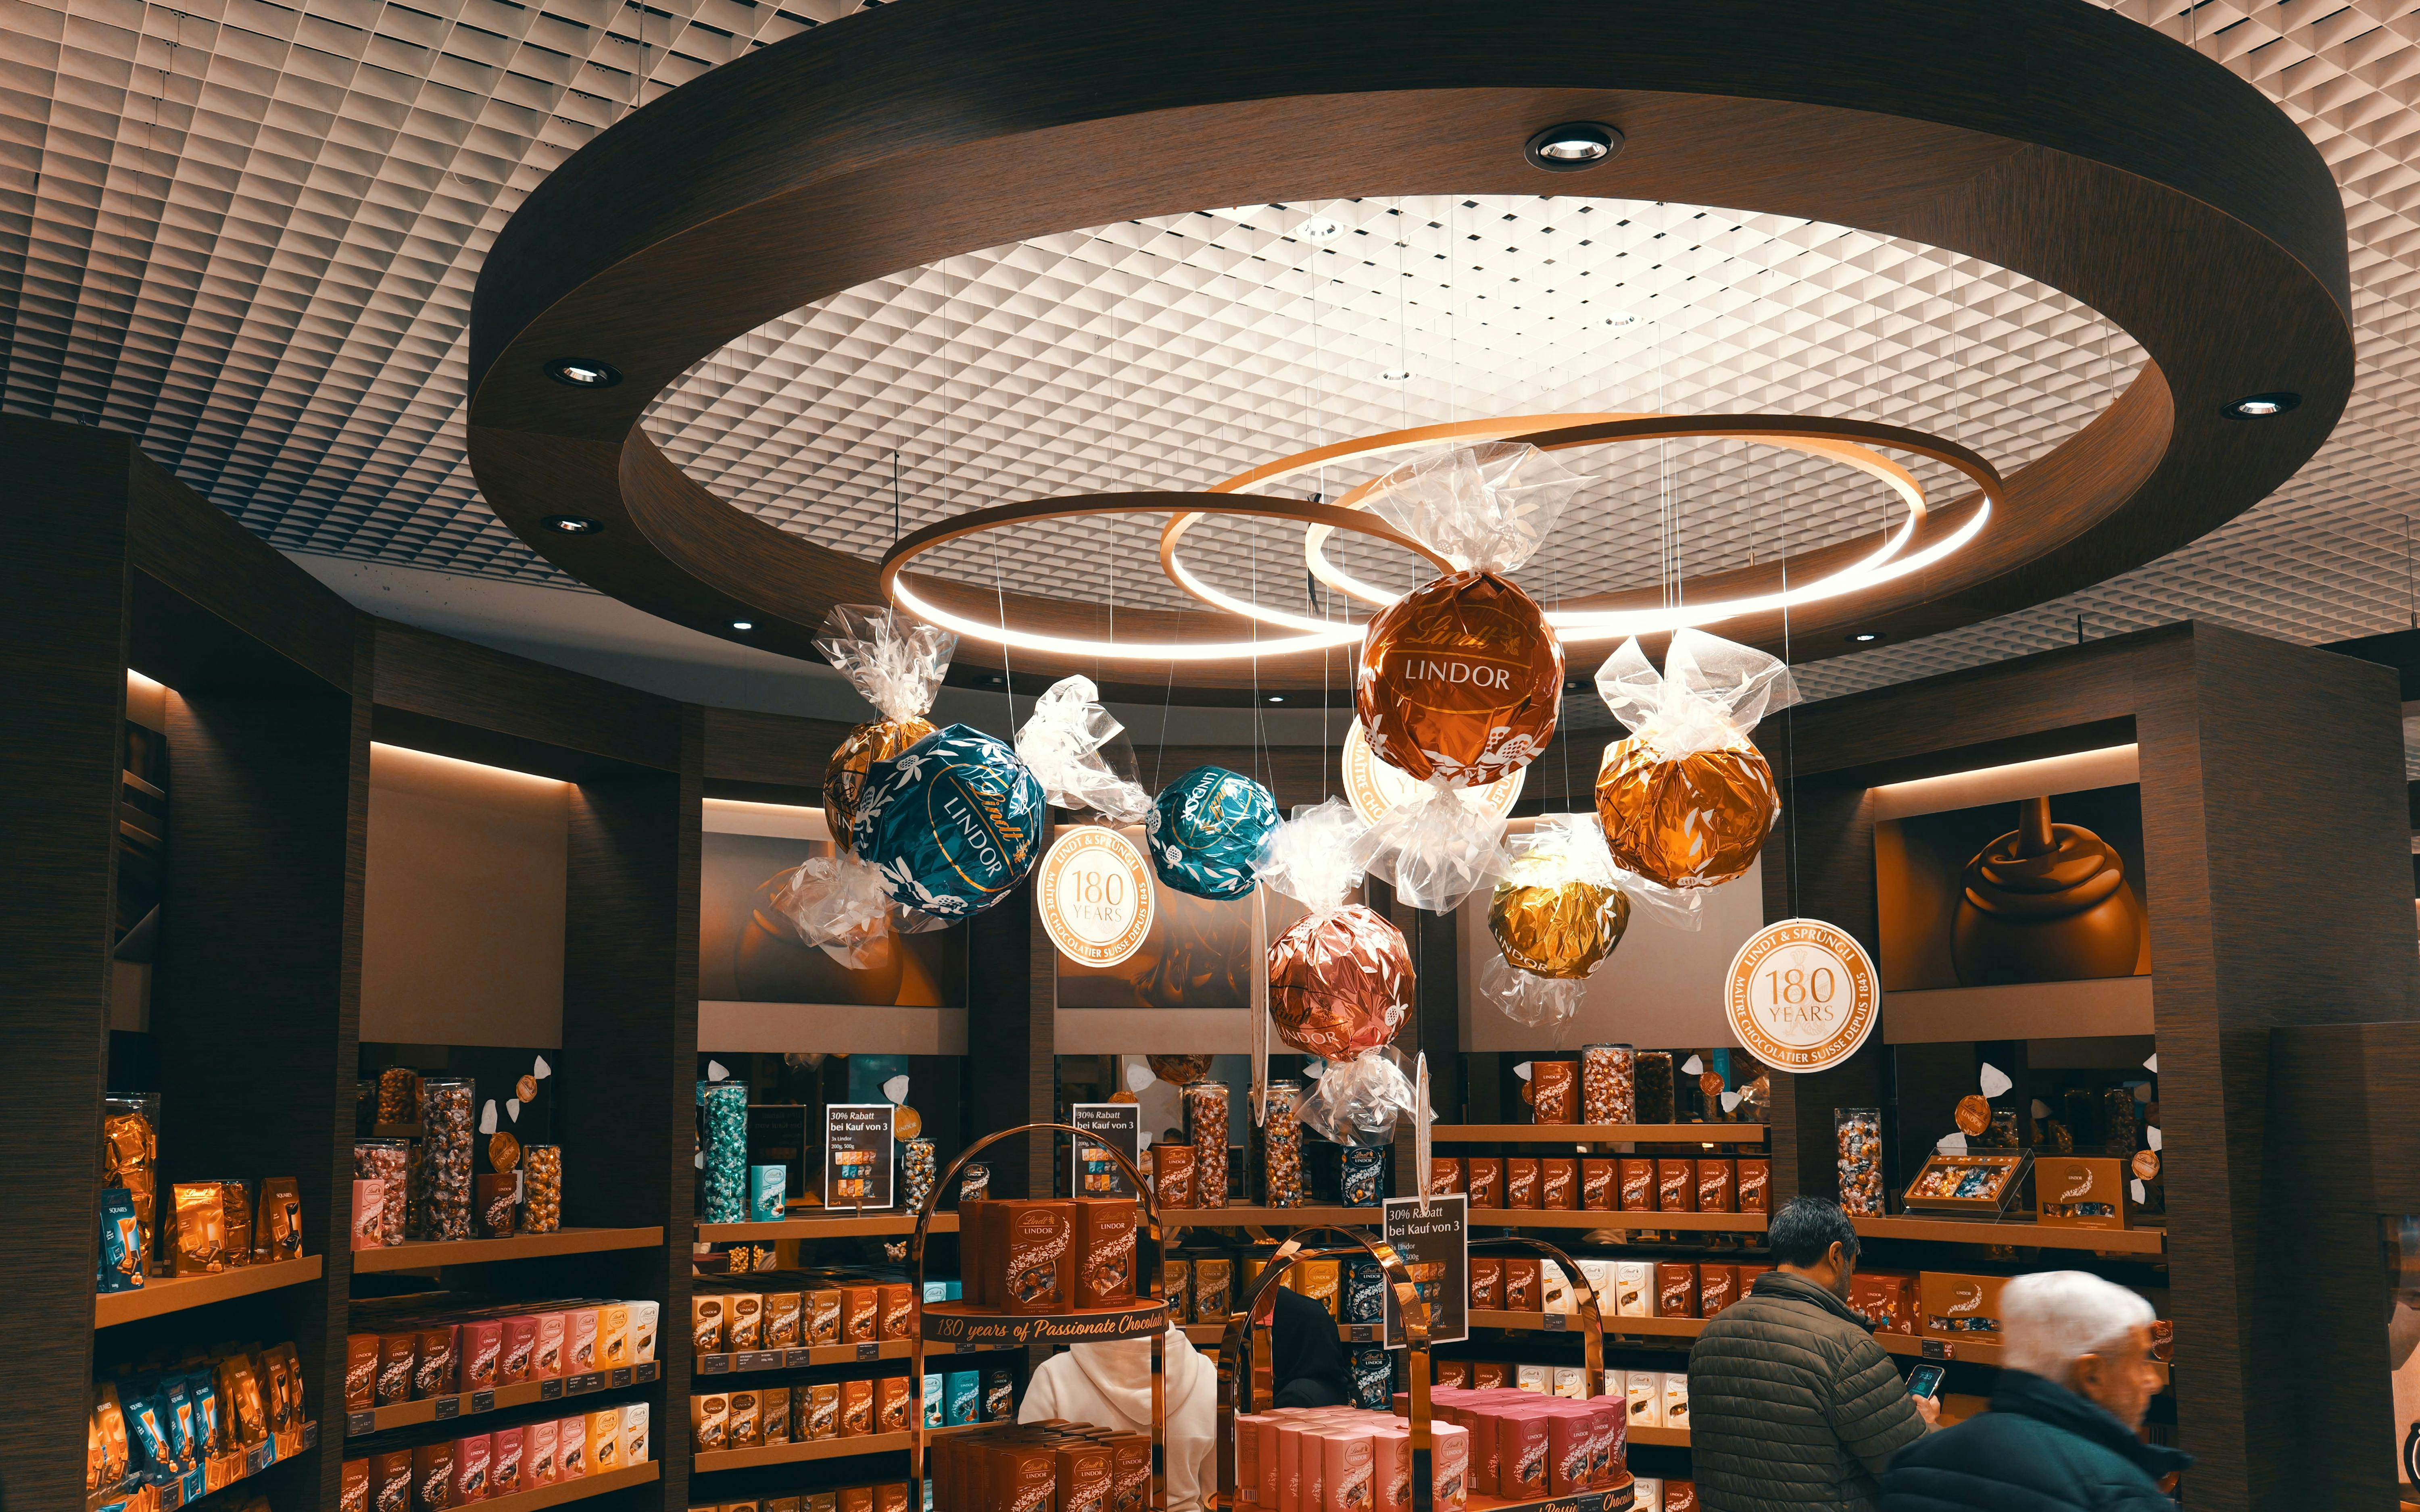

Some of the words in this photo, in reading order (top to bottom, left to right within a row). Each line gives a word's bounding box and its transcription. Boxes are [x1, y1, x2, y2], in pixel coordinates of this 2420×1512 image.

[1405, 616, 1499, 649] Lindt
[1405, 660, 1510, 690] LINDOR
[943, 796, 1002, 878] LINDOR
[1055, 835, 1082, 864] LINDT
[1085, 835, 1093, 845] &
[1094, 835, 1139, 871] SPRÜNGLI
[1046, 871, 1056, 910] MAÎTRE
[1072, 870, 1124, 905] 180
[1139, 882, 1148, 905] 1845
[1073, 904, 1121, 922] YEARS
[1050, 912, 1101, 958] CHOCOLATIER
[1128, 908, 1147, 941] DEPUIS
[1104, 939, 1130, 958] SUISSE
[1495, 928, 1548, 972] LINDOR
[1744, 935, 1777, 967] LINDT
[1781, 931, 1790, 941] &
[1794, 929, 1855, 962] SPRÜNGLI
[1766, 968, 1835, 1005] 180
[1734, 977, 1746, 1018] MAÎTRE
[1741, 1019, 1808, 1062] CHOCOLATIER
[1813, 1038, 1847, 1061] SUISSE
[1848, 1002, 1868, 1040] DEPUIS
[1860, 972, 1869, 998] 1845
[1769, 1006, 1834, 1022] YEARS
[1276, 1022, 1339, 1044] LINDOR
[830, 1112, 848, 1120] 30%
[850, 1112, 874, 1120] Rabatt
[1961, 1112, 1982, 1128] LINDOR
[1965, 1100, 1984, 1118] Lindt
[830, 1123, 844, 1131] bei
[846, 1123, 864, 1131] Kauf
[896, 1122, 917, 1133] LINDOR
[1077, 1121, 1090, 1129] bei
[496, 1146, 515, 1166] LINDOR
[1023, 1216, 1047, 1225] Lindt
[1389, 1209, 1410, 1221] 30%
[1389, 1225, 1404, 1236] bei
[1408, 1223, 1430, 1235] Kauf
[1434, 1224, 1451, 1233] von
[1454, 1220, 1460, 1231] 3
[936, 1318, 964, 1337] 180
[966, 1323, 1008, 1341] years
[1013, 1323, 1030, 1341] of
[1034, 1319, 1115, 1338] Passionate
[1118, 1311, 1162, 1333] Chocolate
